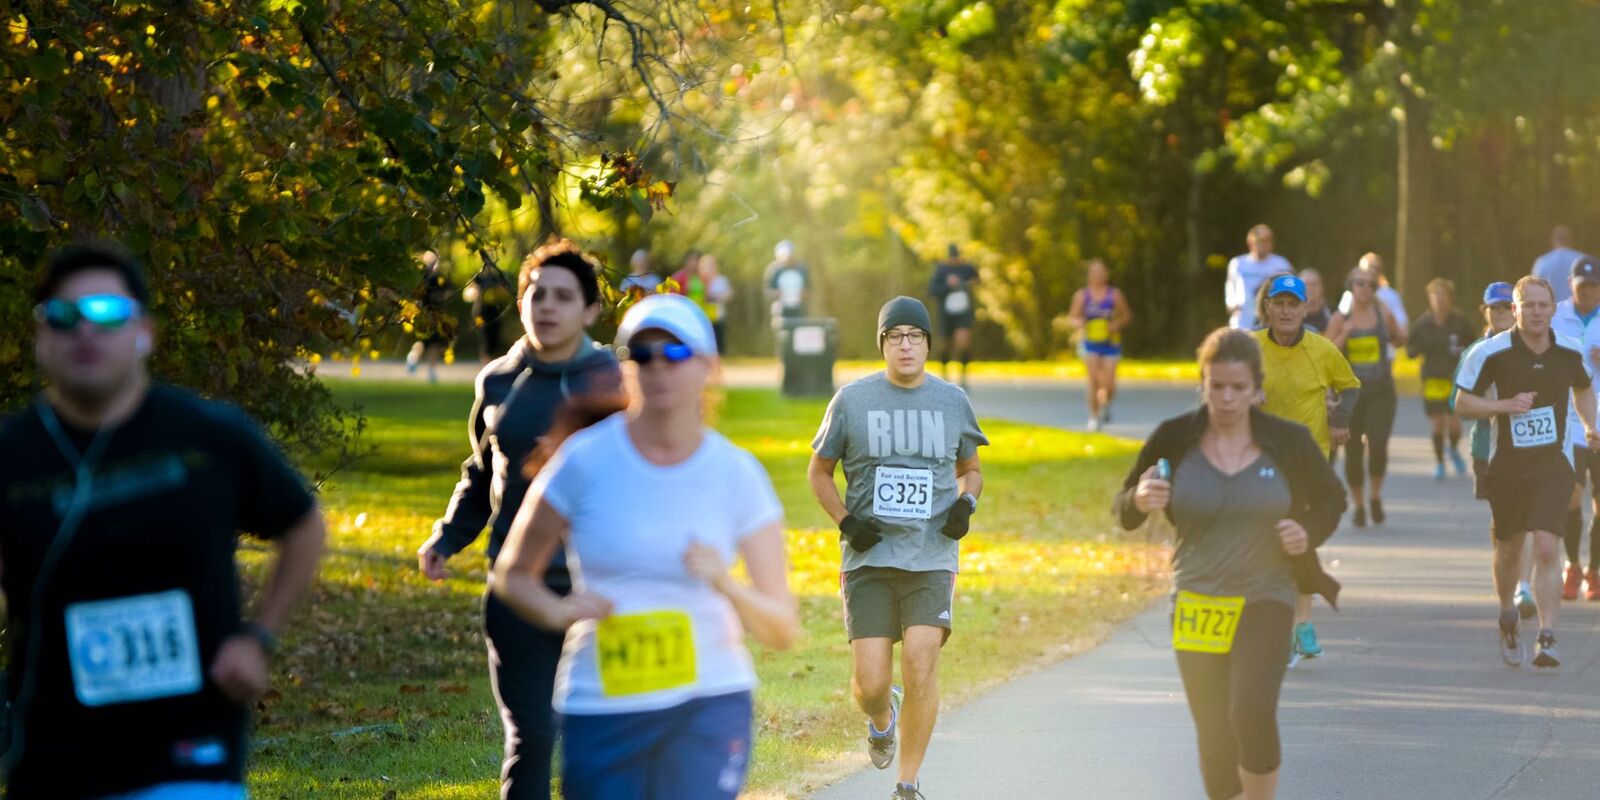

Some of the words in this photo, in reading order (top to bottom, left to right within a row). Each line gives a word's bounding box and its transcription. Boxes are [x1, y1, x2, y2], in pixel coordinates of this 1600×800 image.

[867, 409, 945, 458] RUN
[1514, 416, 1553, 437] C522
[878, 482, 928, 505] C325
[1178, 607, 1237, 636] H727
